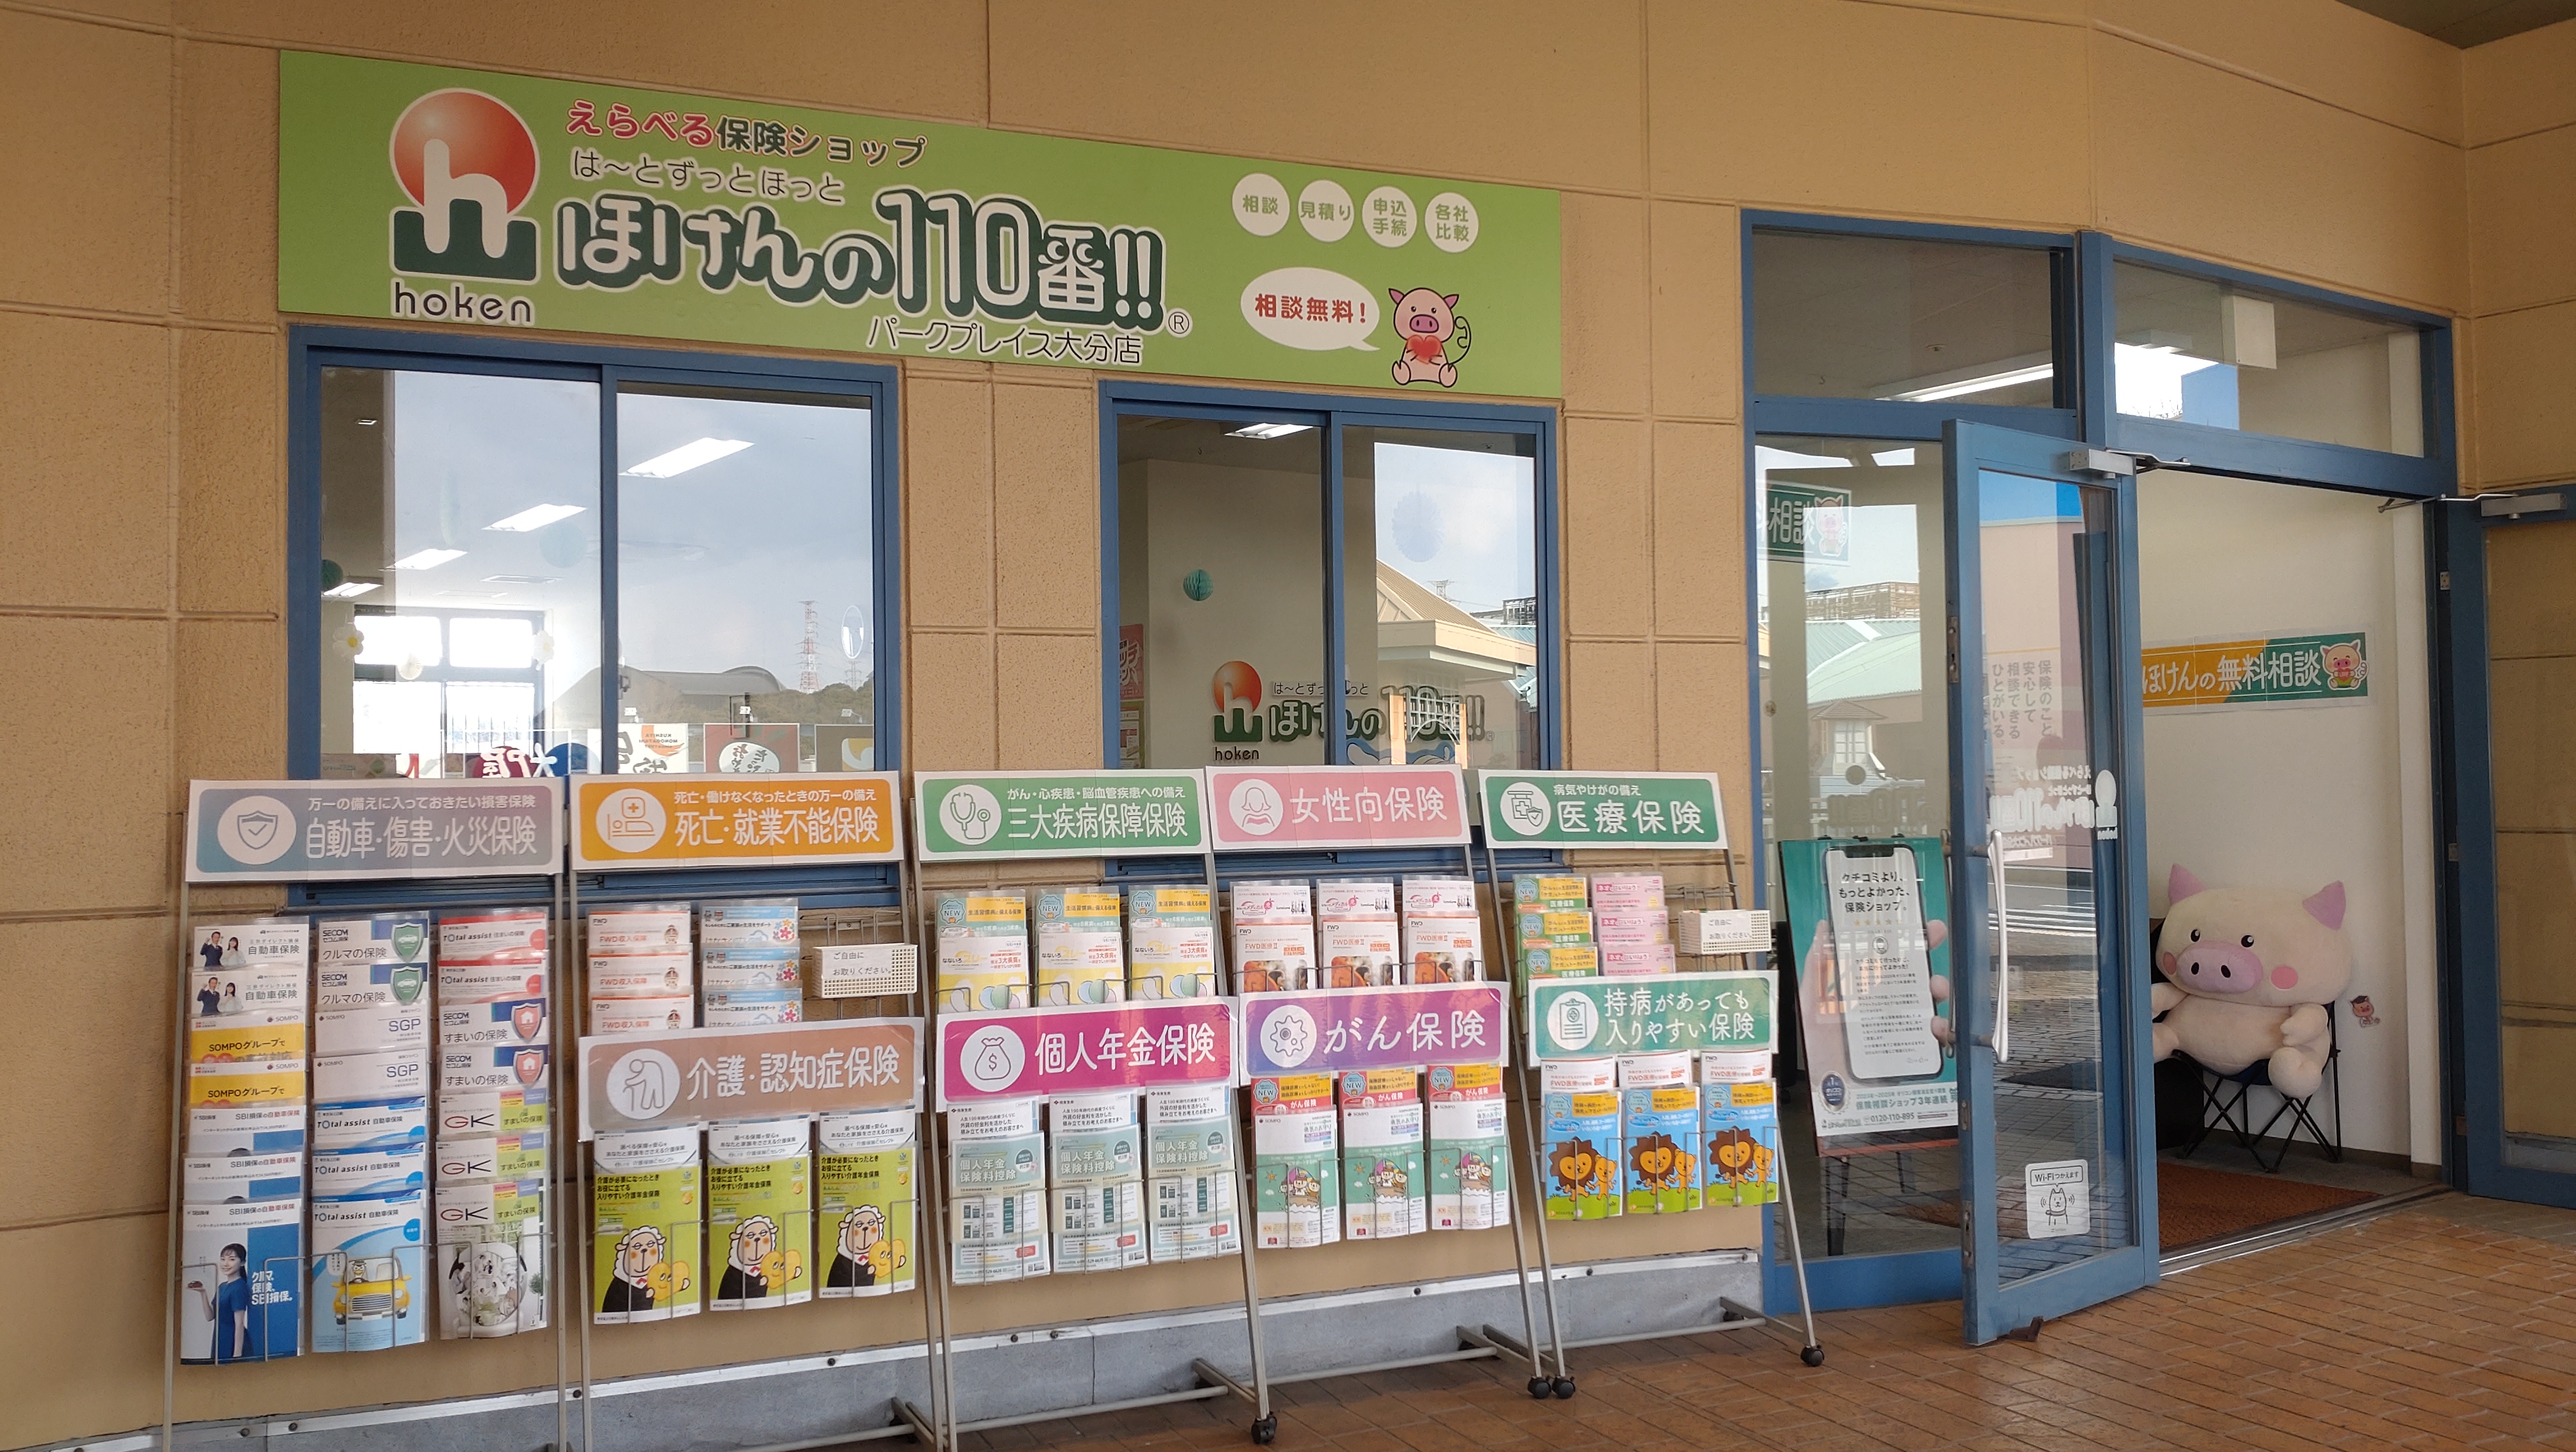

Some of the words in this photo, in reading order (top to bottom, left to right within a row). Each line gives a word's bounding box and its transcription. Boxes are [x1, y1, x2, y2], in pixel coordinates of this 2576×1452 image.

[565, 99, 928, 169] えらべる保険ショップ
[1242, 194, 1279, 217] 相談
[1301, 197, 1353, 222] 見積り
[1372, 197, 1407, 218] 申込
[1435, 203, 1469, 224] 各社
[1372, 216, 1407, 238] 手続
[1436, 222, 1469, 243] 比較
[391, 281, 533, 324] hoken
[868, 318, 1142, 366] パークプレイス大分店
[2023, 661, 2035, 723] 安心して
[2038, 660, 2052, 736] 保険のこと
[2007, 662, 2020, 739] 相談できる
[1215, 746, 1259, 761] hoken
[674, 788, 877, 805] 死亡・働けなくなったときの万一の備え
[1007, 787, 1186, 800] がん・心疾患・脳血管疾患への備え
[1553, 784, 1641, 798] 病気やけがの備え
[308, 795, 536, 811] 万一の備えに入っておきたい損害保険
[1289, 785, 1448, 824] 女性向保険
[1008, 802, 1188, 840] 三大疾病保障保険
[1556, 800, 1705, 835] 医療保険
[675, 806, 880, 847] 死亡・就業不能保険
[306, 817, 537, 859] 自動車・傷害・火災保険
[1842, 872, 1903, 883] クチコミより、
[1839, 886, 1910, 898] もっとよかった、
[1846, 900, 1907, 913] 保険ショップ。
[1708, 918, 1731, 927] ご自由に
[468, 932, 492, 940] assist
[1708, 931, 1752, 939] お取りください。
[248, 945, 300, 955] 自動車保険
[323, 948, 387, 959] クルマの保険
[833, 952, 864, 960] ご自由に
[833, 967, 891, 975] お取りください。
[245, 990, 298, 1000] 自動車保険
[321, 992, 386, 1005] クルマの保険
[1604, 987, 1749, 1017] 持病があっても
[388, 1018, 421, 1032] SGP
[1605, 1012, 1755, 1047] 入りやすい保険
[444, 1029, 508, 1044] すまいの保険
[1323, 1009, 1486, 1055] がん保険
[209, 1040, 286, 1052] SOMPOグループで
[1034, 1023, 1216, 1076] 個人年金保険
[387, 1064, 418, 1078] SGP
[687, 1044, 900, 1101] 介護・認知症保険
[445, 1074, 509, 1086] すまいの保険
[208, 1086, 285, 1098] SOMPOグループで
[1378, 1092, 1403, 1101] がん保険
[1465, 1088, 1488, 1096] がん保険
[1290, 1099, 1317, 1109] がん保険
[236, 1110, 300, 1120] SBI損保の自動車保険
[344, 1118, 371, 1127] assist
[373, 1116, 402, 1125] 自動車保険
[444, 1114, 494, 1129] GK
[503, 1116, 542, 1125] すまいの保険
[1871, 1113, 1914, 1122] 0120-110-895
[960, 1119, 1012, 1128] 外貨の好金利を活かした
[1155, 1139, 1198, 1152] 個人年金
[821, 1155, 878, 1164] 介護が必要になったとき
[1061, 1149, 1105, 1161] 個人年金
[1156, 1150, 1208, 1164] 保険料控除
[230, 1157, 296, 1168] SBI損保の自動車保険
[370, 1161, 401, 1171] 自動車保険
[441, 1159, 491, 1175] GK
[500, 1160, 540, 1171] すまいの保険
[960, 1158, 1006, 1170] 個人年金
[1061, 1160, 1116, 1175] 保険料控除
[710, 1165, 770, 1175] 介護が必要になったとき
[821, 1171, 880, 1180] 入りやすい介護年金保険
[960, 1169, 1016, 1182] 保険料控除
[597, 1175, 659, 1184] 介護が必要になったとき
[710, 1181, 771, 1191] 入りやすい介護年金保険
[597, 1191, 659, 1200] 入りやすい介護年金保険
[229, 1203, 295, 1216] SBI損保の自動車保険
[341, 1212, 366, 1220] assist
[369, 1209, 399, 1219] 自動車保険
[440, 1207, 488, 1221] GK
[497, 1207, 535, 1219] すまいの保険
